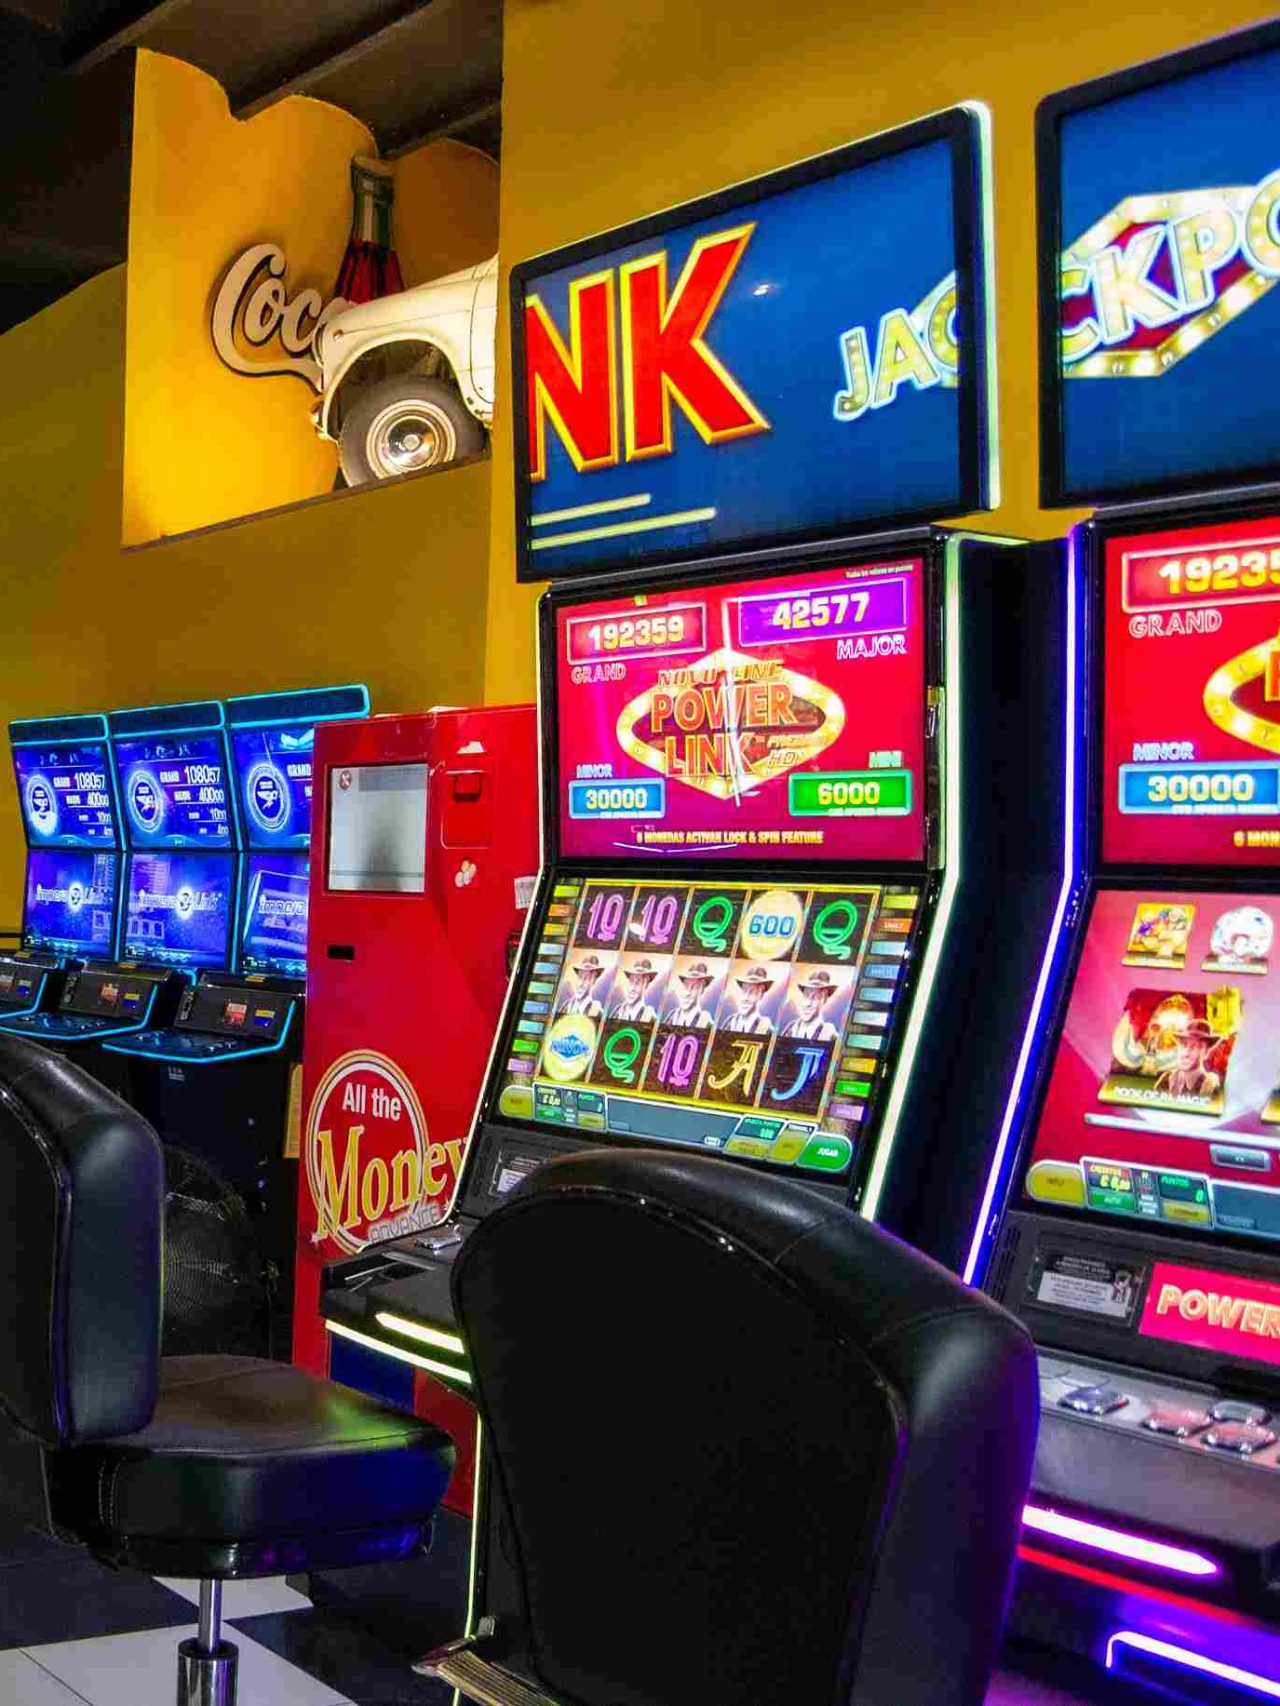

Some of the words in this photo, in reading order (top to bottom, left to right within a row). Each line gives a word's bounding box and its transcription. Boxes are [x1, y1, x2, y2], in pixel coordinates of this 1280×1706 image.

[772, 591, 870, 630] 42577
[1129, 609, 1222, 638] GRAND
[588, 615, 685, 651] 192359
[836, 634, 907, 660] MAJOR
[571, 662, 626, 684] GRAND
[651, 683, 799, 733] POWER
[664, 732, 756, 777] LINK
[1133, 742, 1194, 761] MINOR
[586, 788, 648, 809] 30000
[818, 781, 880, 805] 6000
[1148, 774, 1255, 802] 30000
[723, 831, 747, 843] LOCK
[693, 896, 734, 952] Q
[748, 914, 796, 937] 600
[813, 900, 858, 960] Q
[604, 1027, 641, 1083] Q
[707, 1039, 763, 1097] A
[771, 1046, 825, 1101] J
[342, 1082, 366, 1115] All
[371, 1087, 402, 1121] the
[1156, 1283, 1280, 1340] POWER
